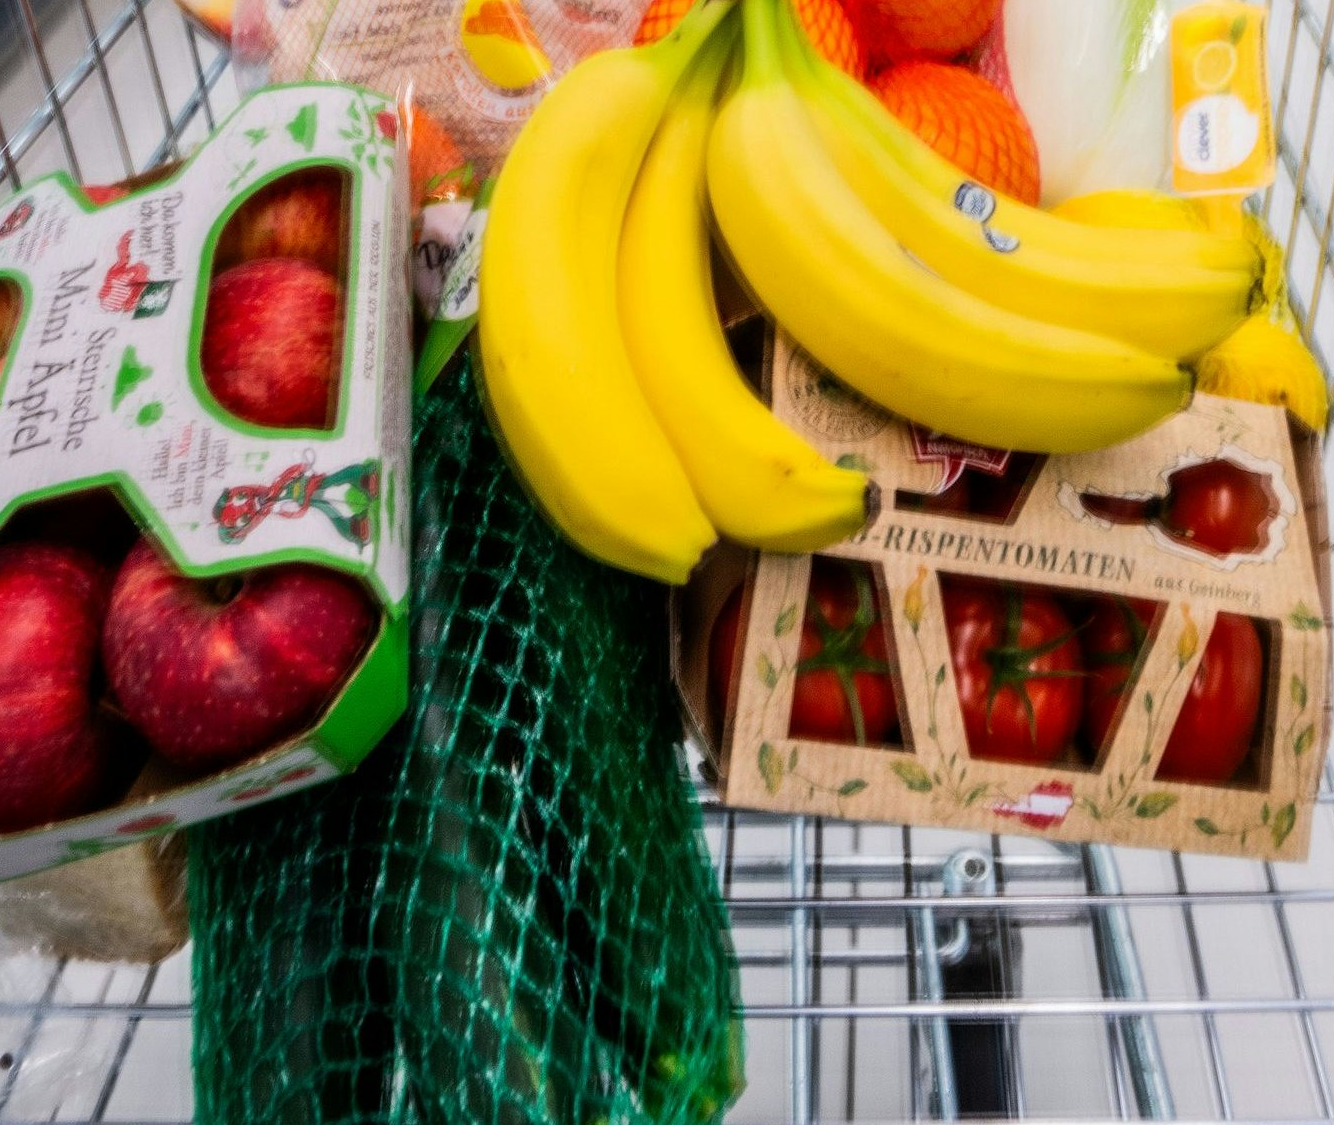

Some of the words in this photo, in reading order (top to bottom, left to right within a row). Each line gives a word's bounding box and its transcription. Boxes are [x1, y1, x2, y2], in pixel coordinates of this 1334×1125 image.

[39, 258, 97, 348] Mini
[8, 359, 77, 458] Äpfel
[61, 326, 116, 452] Steirische
[1154, 575, 1183, 592] aus
